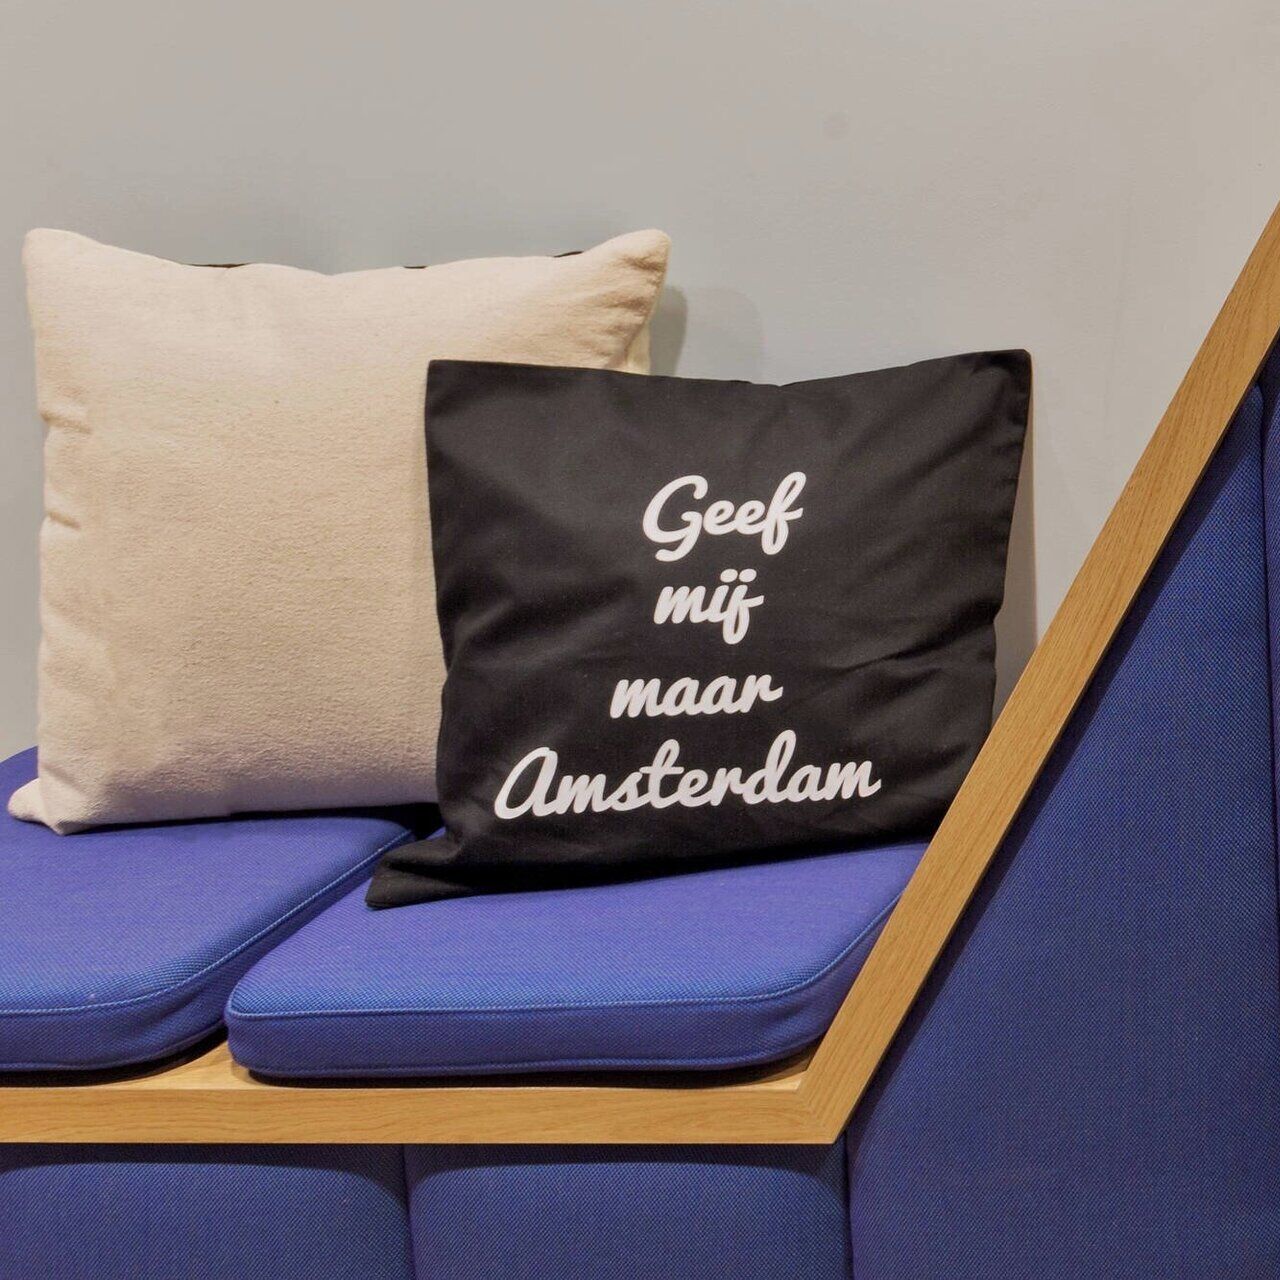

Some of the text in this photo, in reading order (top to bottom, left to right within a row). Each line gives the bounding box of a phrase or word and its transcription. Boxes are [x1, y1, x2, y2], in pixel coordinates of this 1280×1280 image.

[642, 471, 807, 562] Geef
[653, 568, 765, 645] mij
[609, 674, 784, 719] maar
[494, 729, 882, 820] Amsterdam
